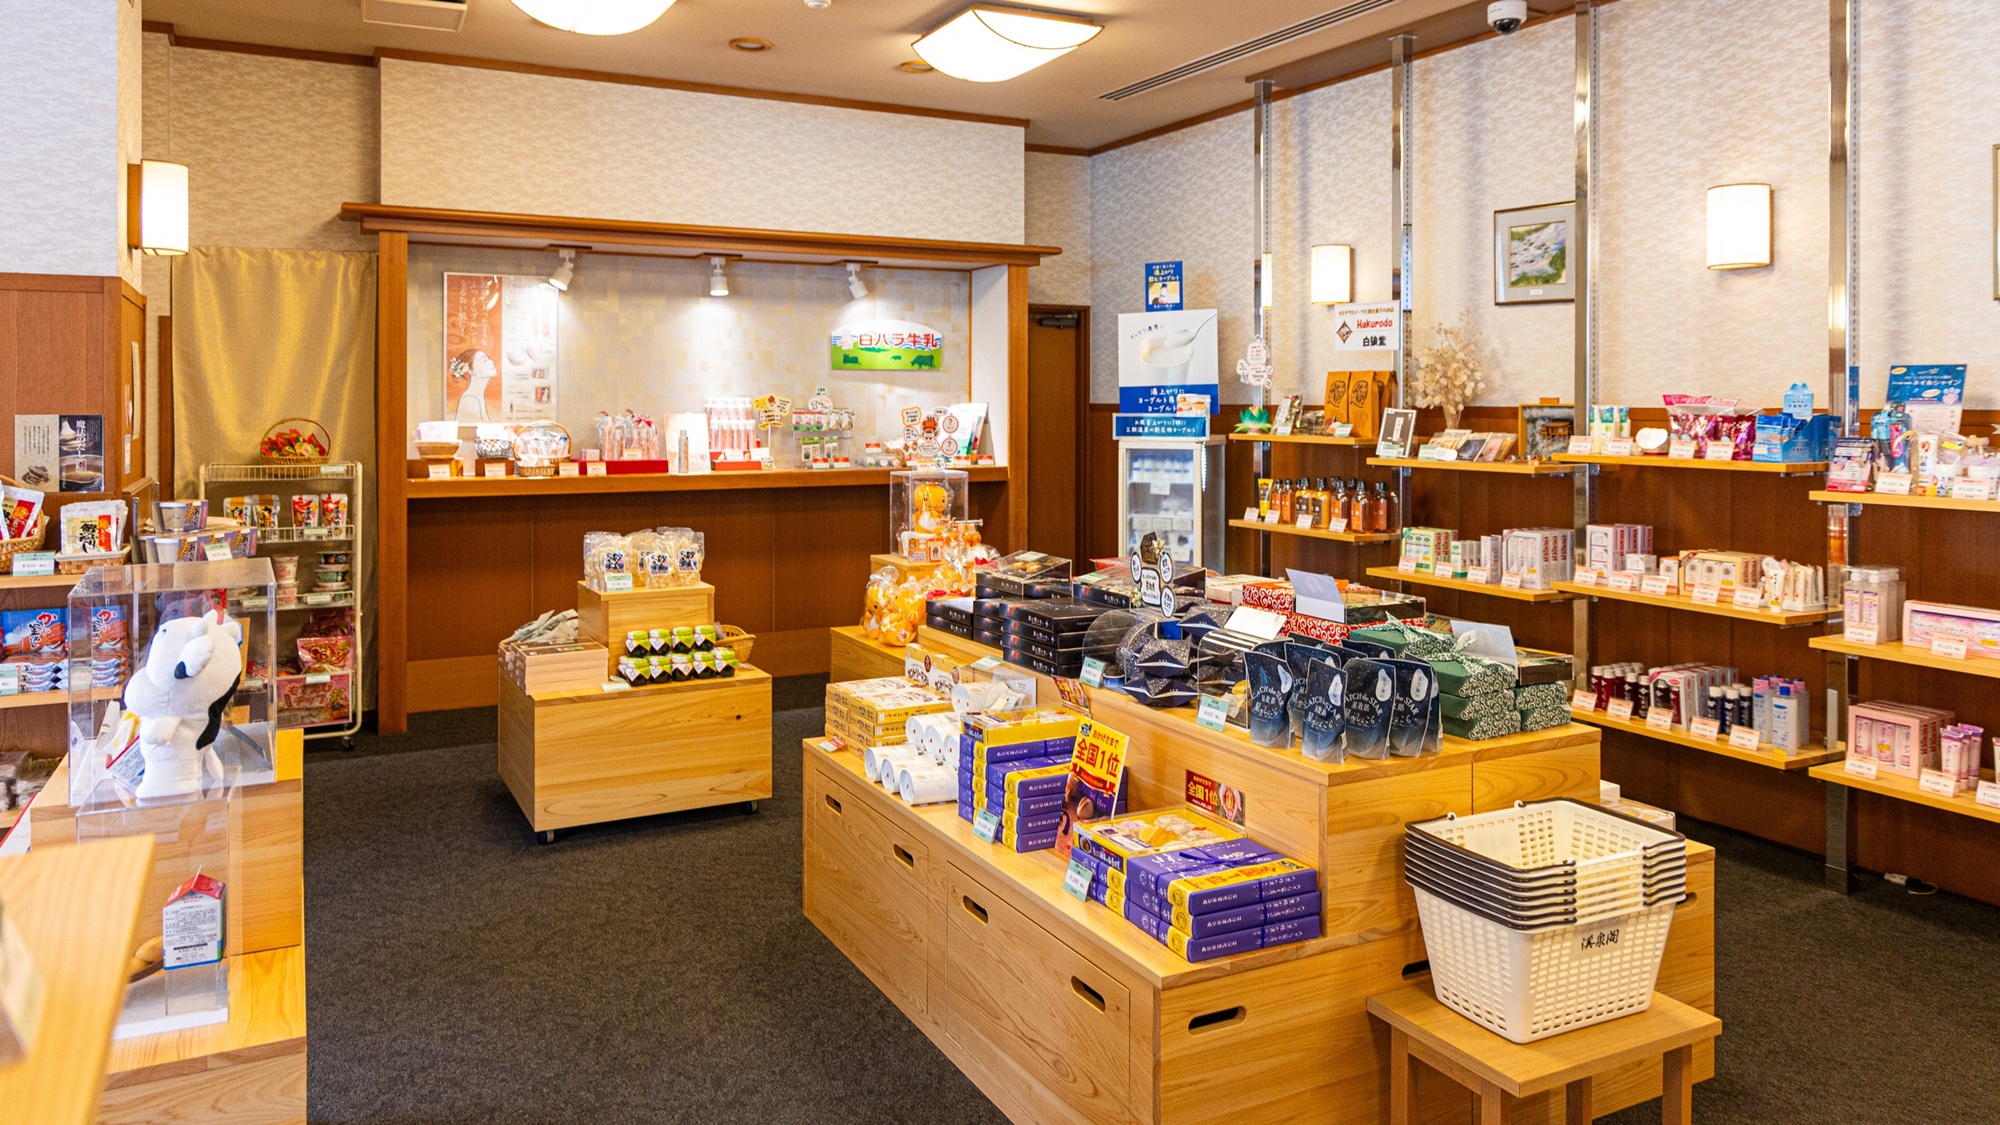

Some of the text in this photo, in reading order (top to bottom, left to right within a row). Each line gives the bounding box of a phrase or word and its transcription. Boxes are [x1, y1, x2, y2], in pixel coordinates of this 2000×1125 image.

[1356, 318, 1393, 329] Hakurodo
[1150, 388, 1185, 396] 湯上がりに
[75, 419, 87, 458] 魔法のだし
[1325, 702, 1341, 720] STAR
[1368, 697, 1383, 716] STAR
[1403, 697, 1419, 716] STAR
[1092, 729, 1120, 748] おかげさまで
[1075, 738, 1120, 778] 全国1位
[1187, 781, 1218, 807] 全国1位
